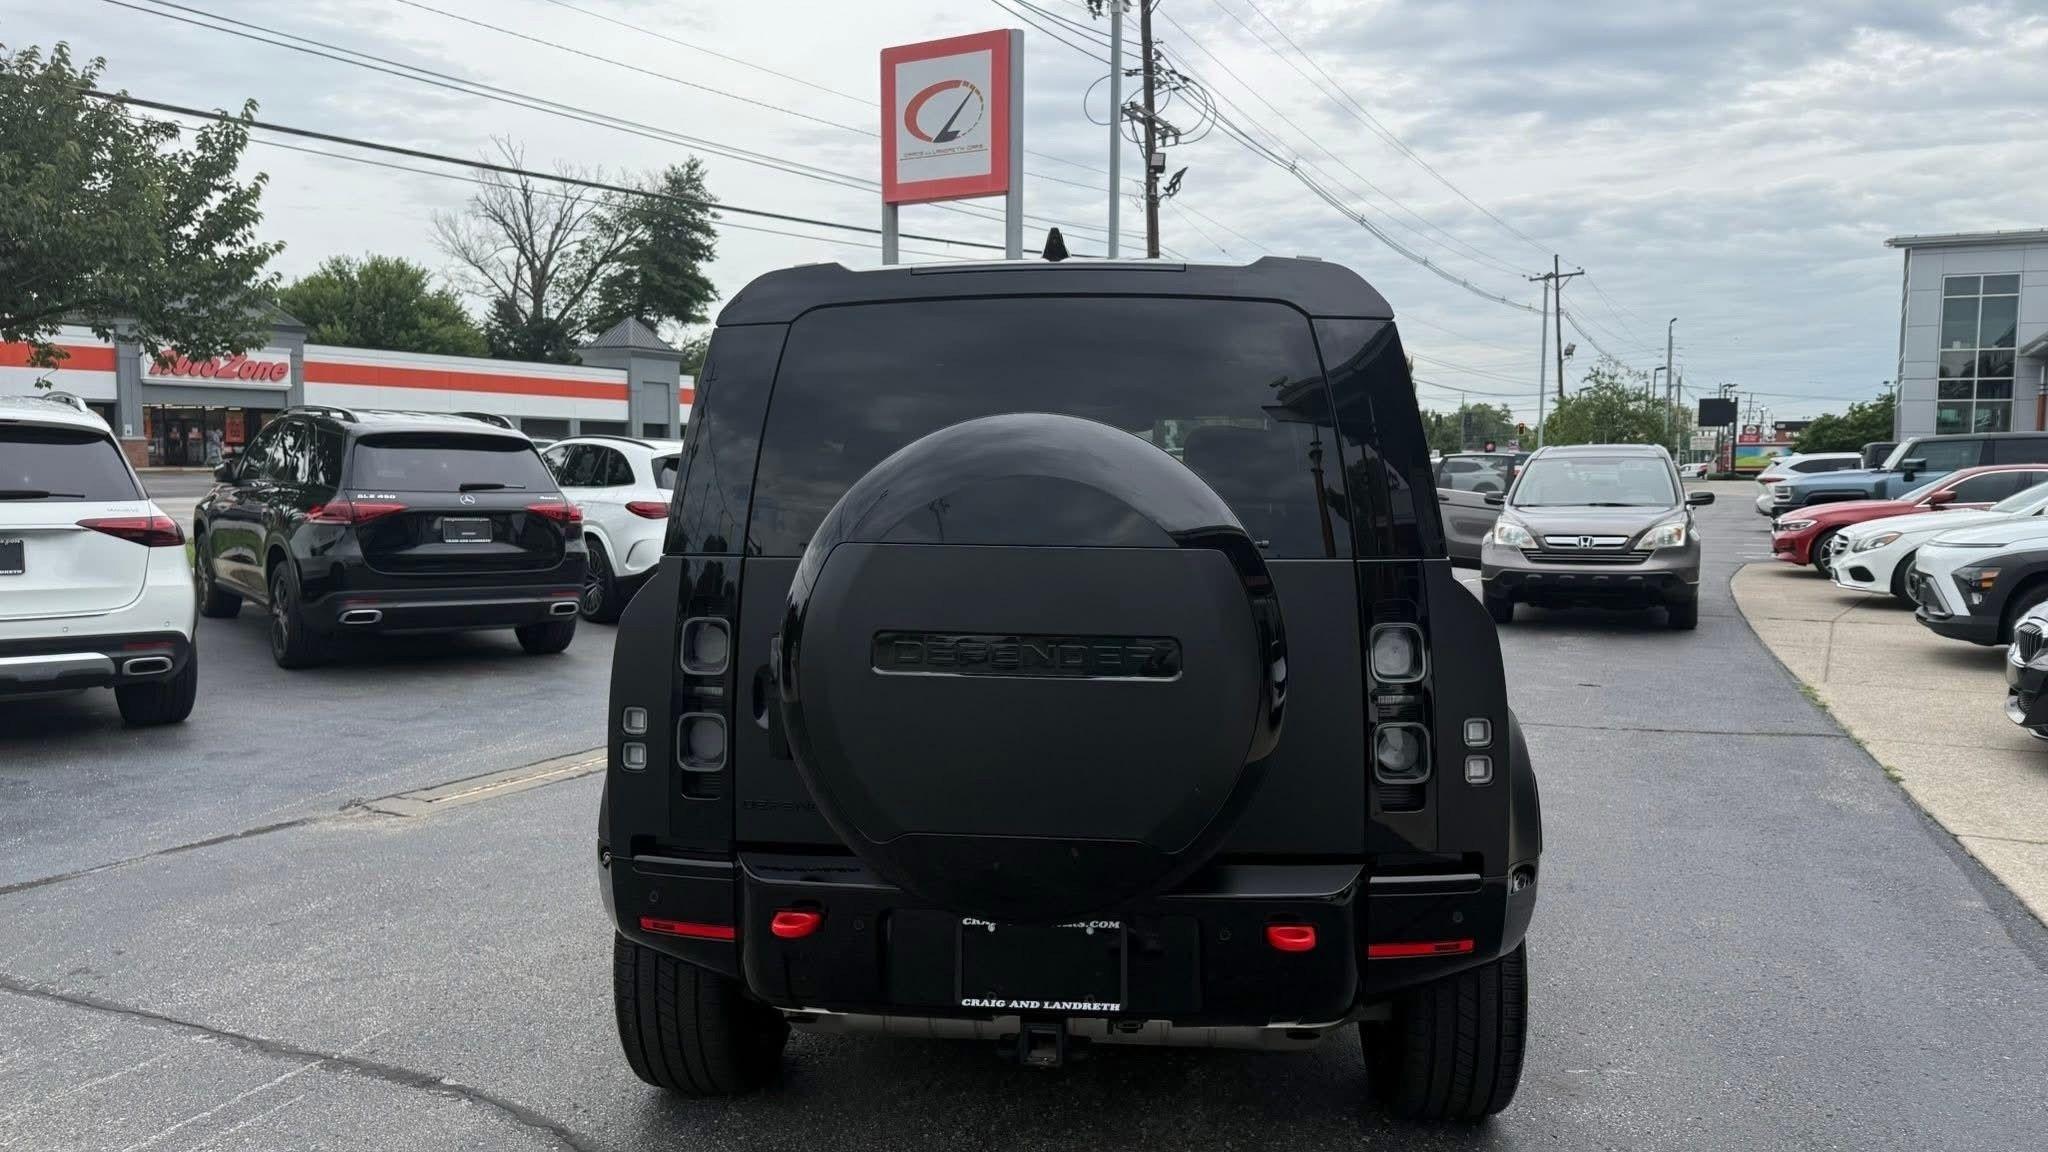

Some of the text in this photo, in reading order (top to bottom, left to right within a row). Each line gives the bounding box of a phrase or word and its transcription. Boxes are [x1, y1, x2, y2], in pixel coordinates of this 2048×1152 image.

[891, 639, 1163, 671] DEFENDER
[961, 998, 1121, 1011] CRAIG AND LANDRETH
